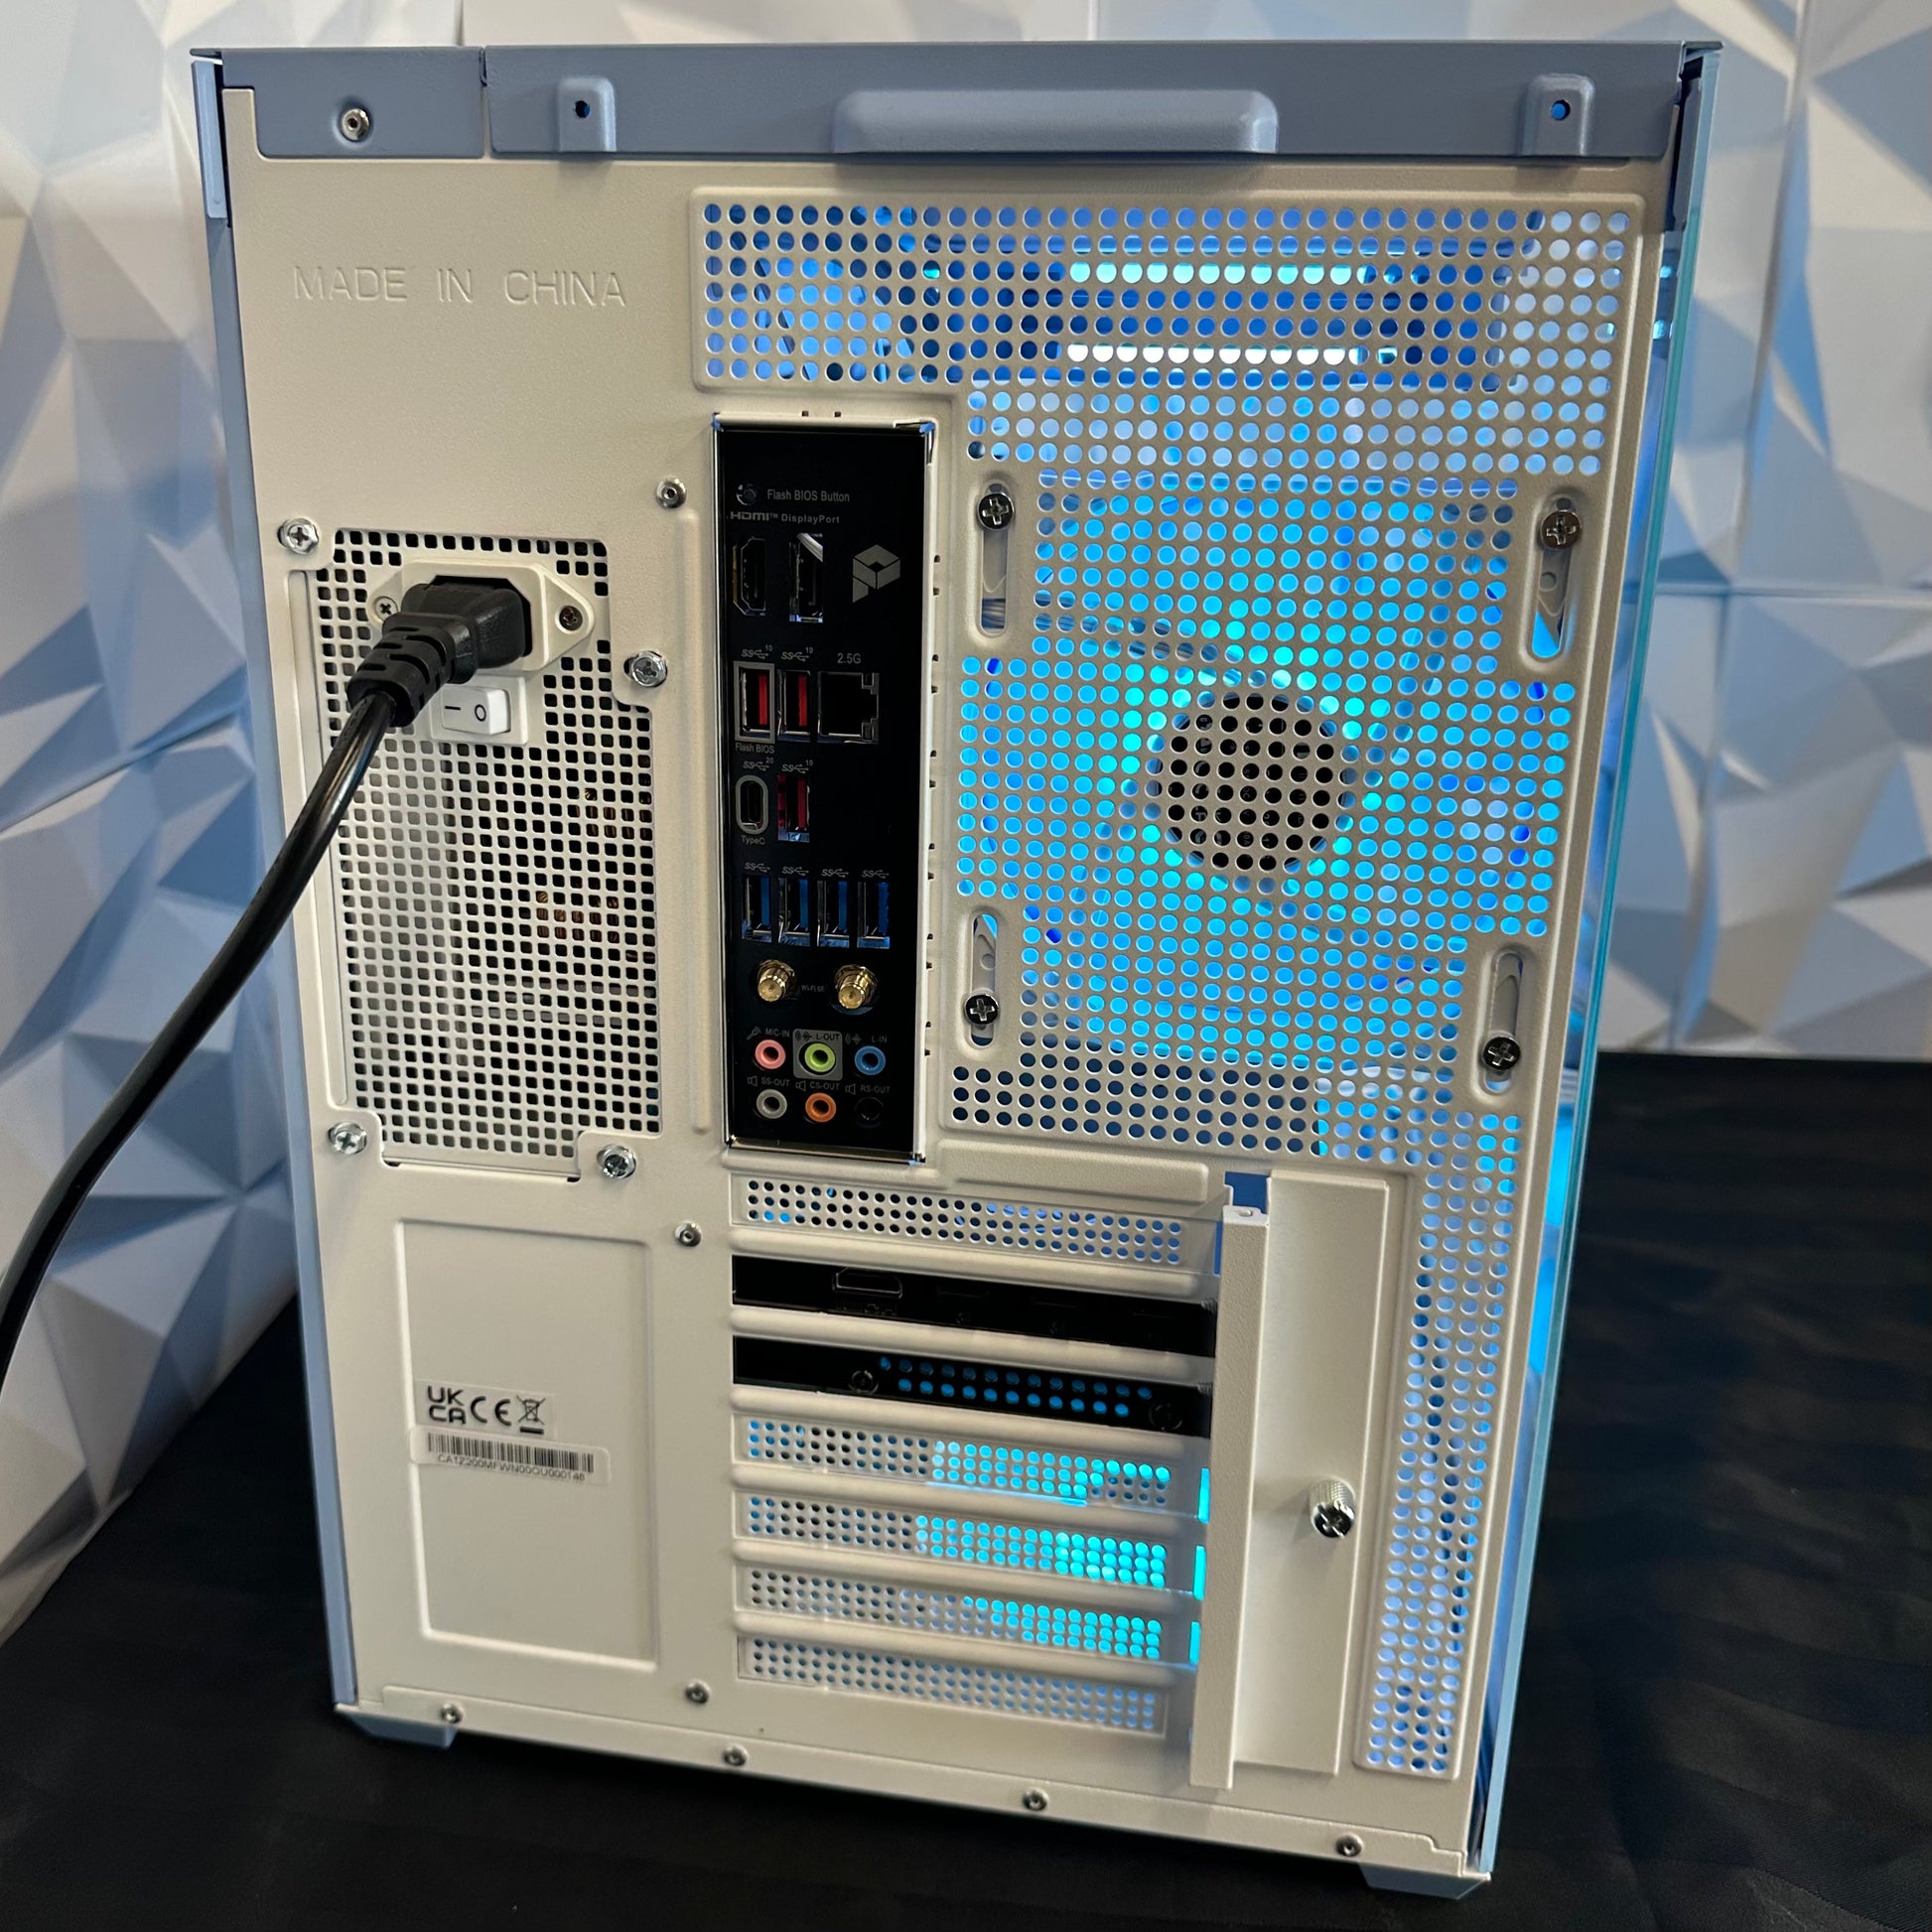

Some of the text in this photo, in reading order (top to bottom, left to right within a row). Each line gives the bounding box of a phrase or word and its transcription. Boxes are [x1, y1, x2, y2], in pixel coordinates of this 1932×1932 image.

[294, 266, 626, 307] MADE IN CHINA
[767, 488, 850, 502] Flash BIOS Button
[781, 513, 840, 525] DisplayPort
[837, 653, 862, 664] 2.5G
[735, 742, 775, 755] Flash BIOS
[741, 835, 765, 845] TypeC
[764, 1028, 790, 1038] MIC-IN
[816, 1033, 840, 1041] L-OUT
[871, 1035, 888, 1043] L-IN
[760, 1076, 790, 1087] SS-OUT
[809, 1081, 840, 1091] CS-OUT
[860, 1084, 891, 1094] RS-OUT
[427, 1385, 464, 1406] UK
[429, 1404, 467, 1425] CA
[470, 1395, 512, 1427] CE
